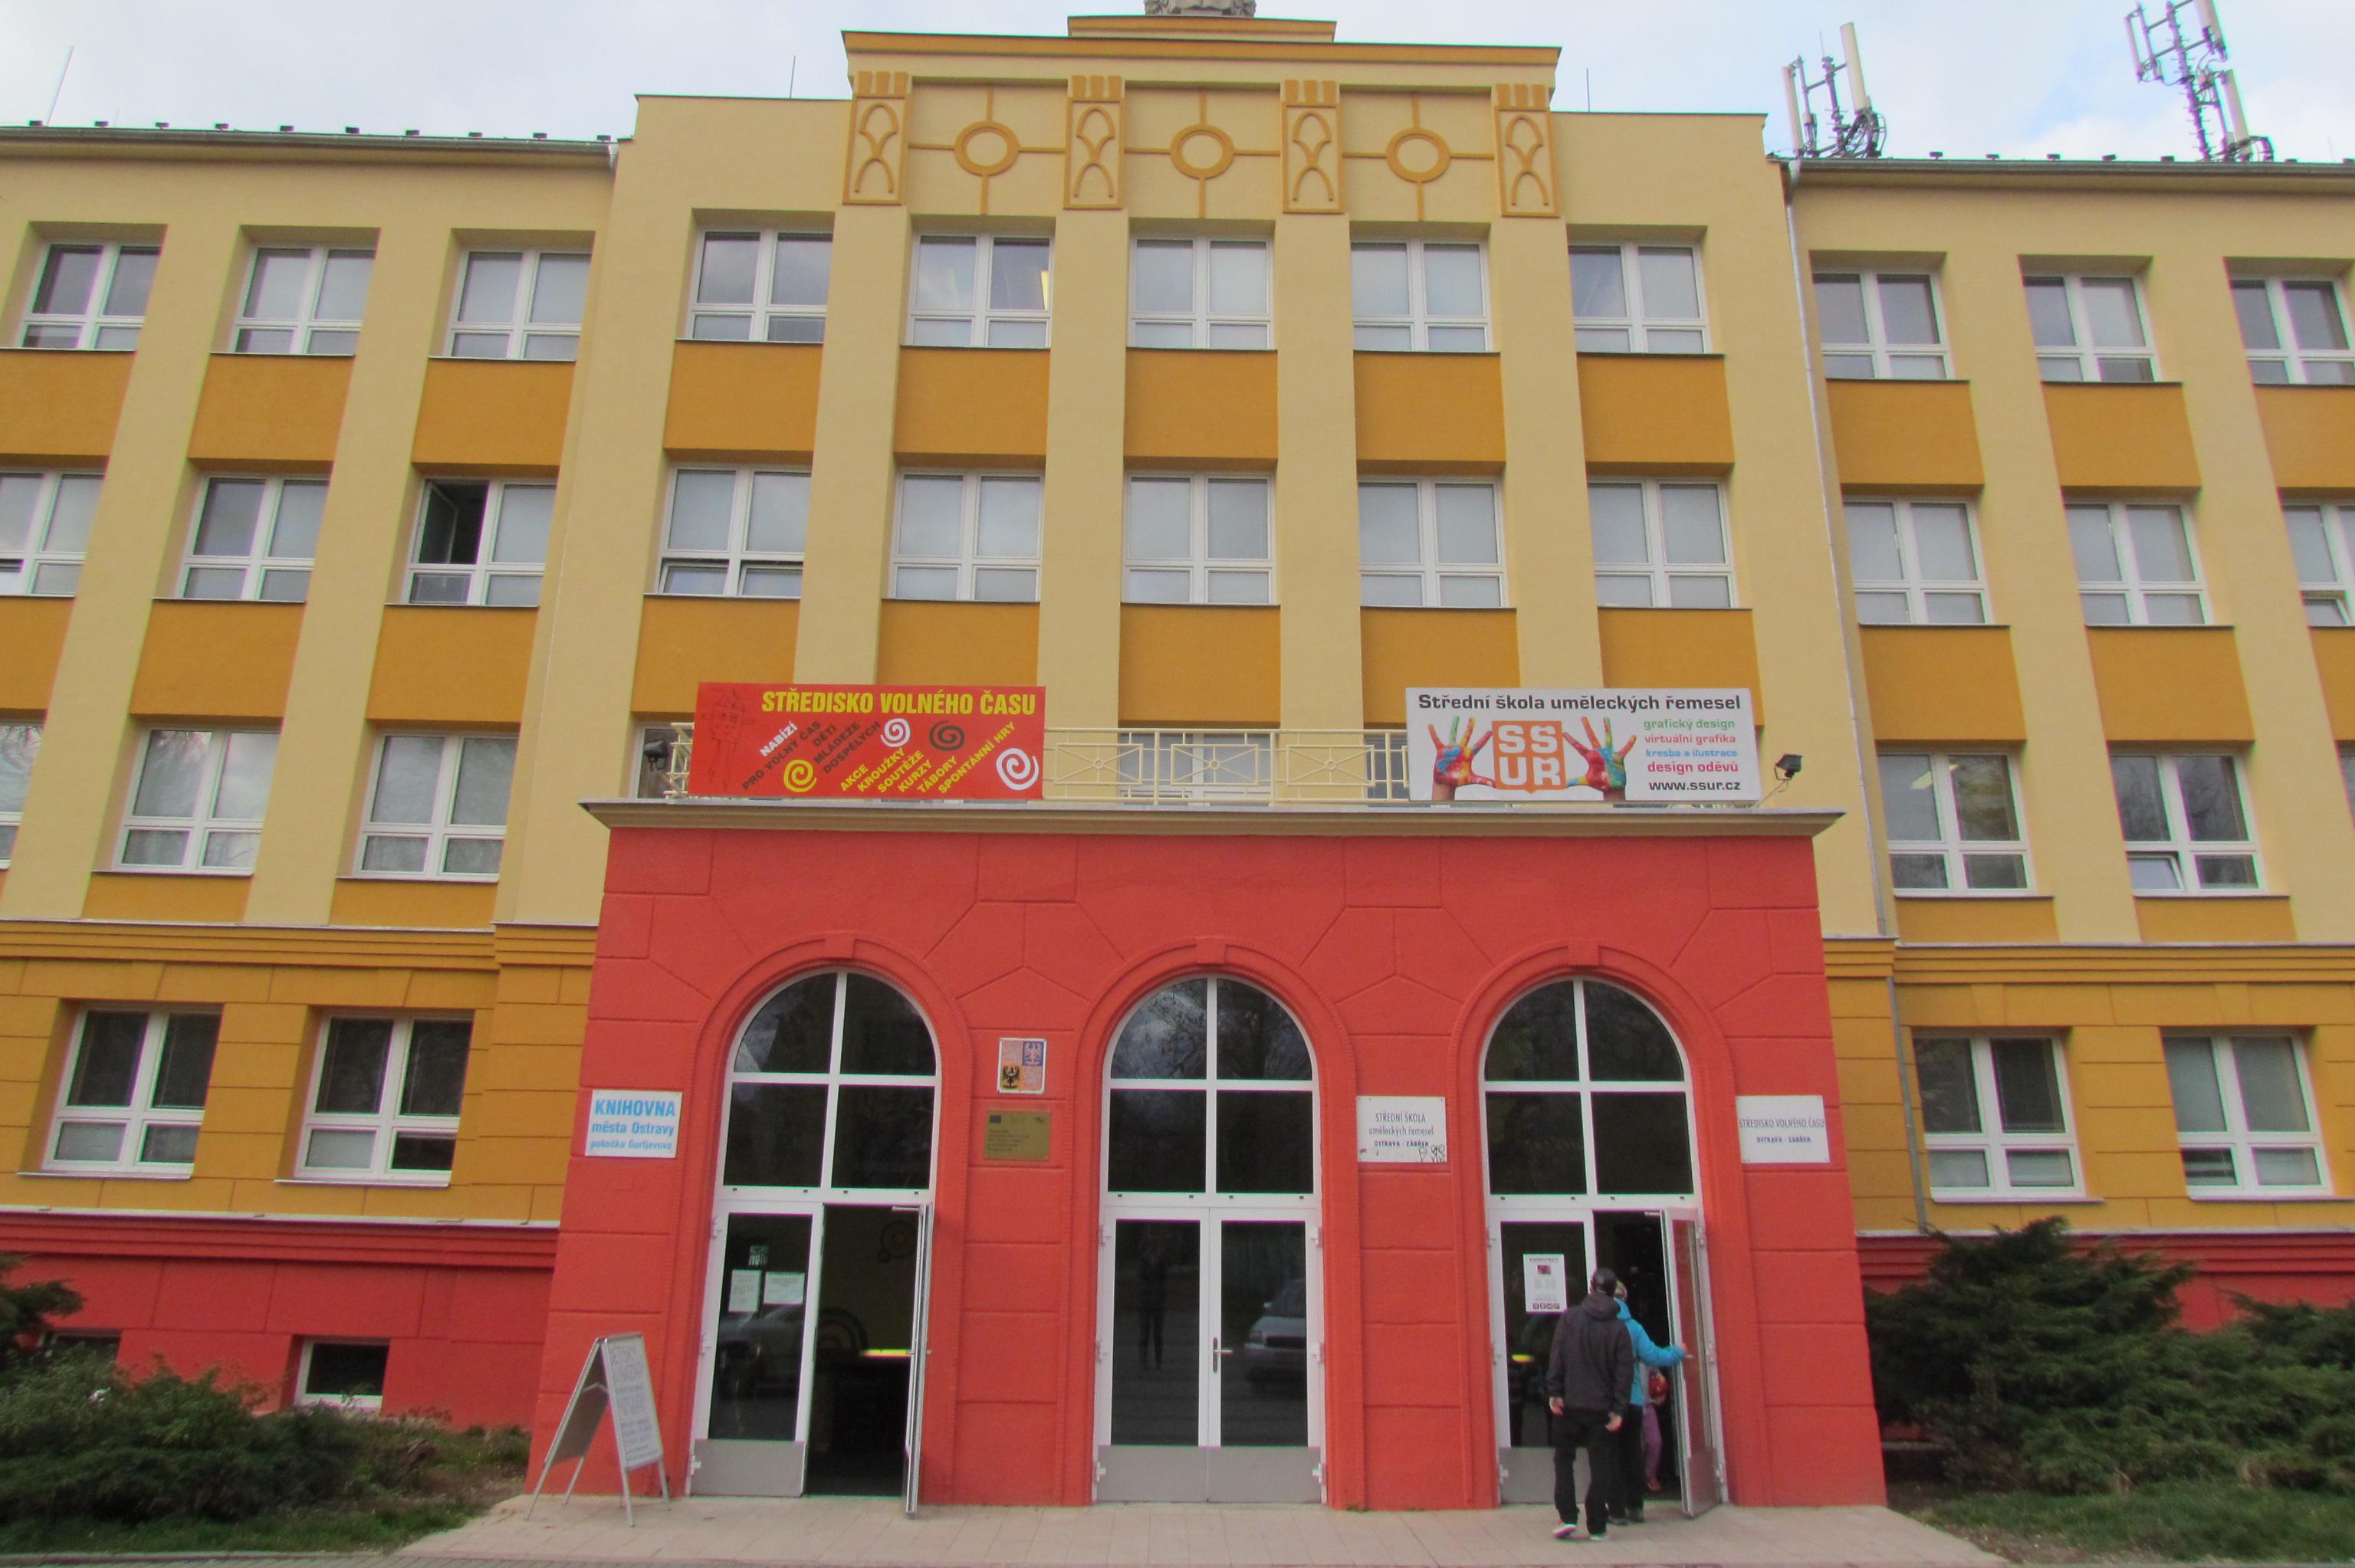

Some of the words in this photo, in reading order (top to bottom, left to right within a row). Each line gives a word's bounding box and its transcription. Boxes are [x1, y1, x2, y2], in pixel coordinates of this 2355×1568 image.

[761, 687, 873, 713] STŘEDISKO
[880, 689, 974, 714] VOLNÉHO
[980, 690, 1036, 715] ČASU
[1418, 694, 1490, 710] Střední
[1496, 694, 1545, 710] škola
[1551, 694, 1660, 713] uměleckých
[1665, 695, 1741, 710] řemesel
[1644, 719, 1693, 730] grafický
[1696, 719, 1735, 730] design
[760, 720, 798, 756] NABÍZÍ
[1644, 734, 1693, 743] virtuální
[1696, 734, 1736, 746] grafika
[742, 769, 764, 790] PRO
[765, 739, 798, 770] VOLNÝ
[799, 720, 821, 741] ČAS
[938, 739, 995, 793] SPONTÁNNÍ
[994, 721, 1015, 743] HRY
[1646, 749, 1681, 757] kresba
[1693, 749, 1738, 757] ilustrace
[840, 764, 869, 791] AKCE
[857, 747, 905, 792] KROUŽKY
[877, 750, 924, 793] SOUTĚŽE
[898, 759, 932, 792] KURZY
[917, 756, 957, 793] TÁBORY
[1647, 761, 1693, 775] design
[1697, 761, 1739, 773] oděvů
[1649, 782, 1741, 791] www.ssur.cz
[594, 1099, 676, 1117] KNIHOVNA
[1375, 1110, 1403, 1123] STŘEDNÍ
[1404, 1110, 1426, 1123] ŠKOLA
[592, 1120, 627, 1133] města
[632, 1121, 675, 1137] Ostravy
[1368, 1125, 1407, 1137] uměleckých
[1407, 1125, 1434, 1135] řemesel
